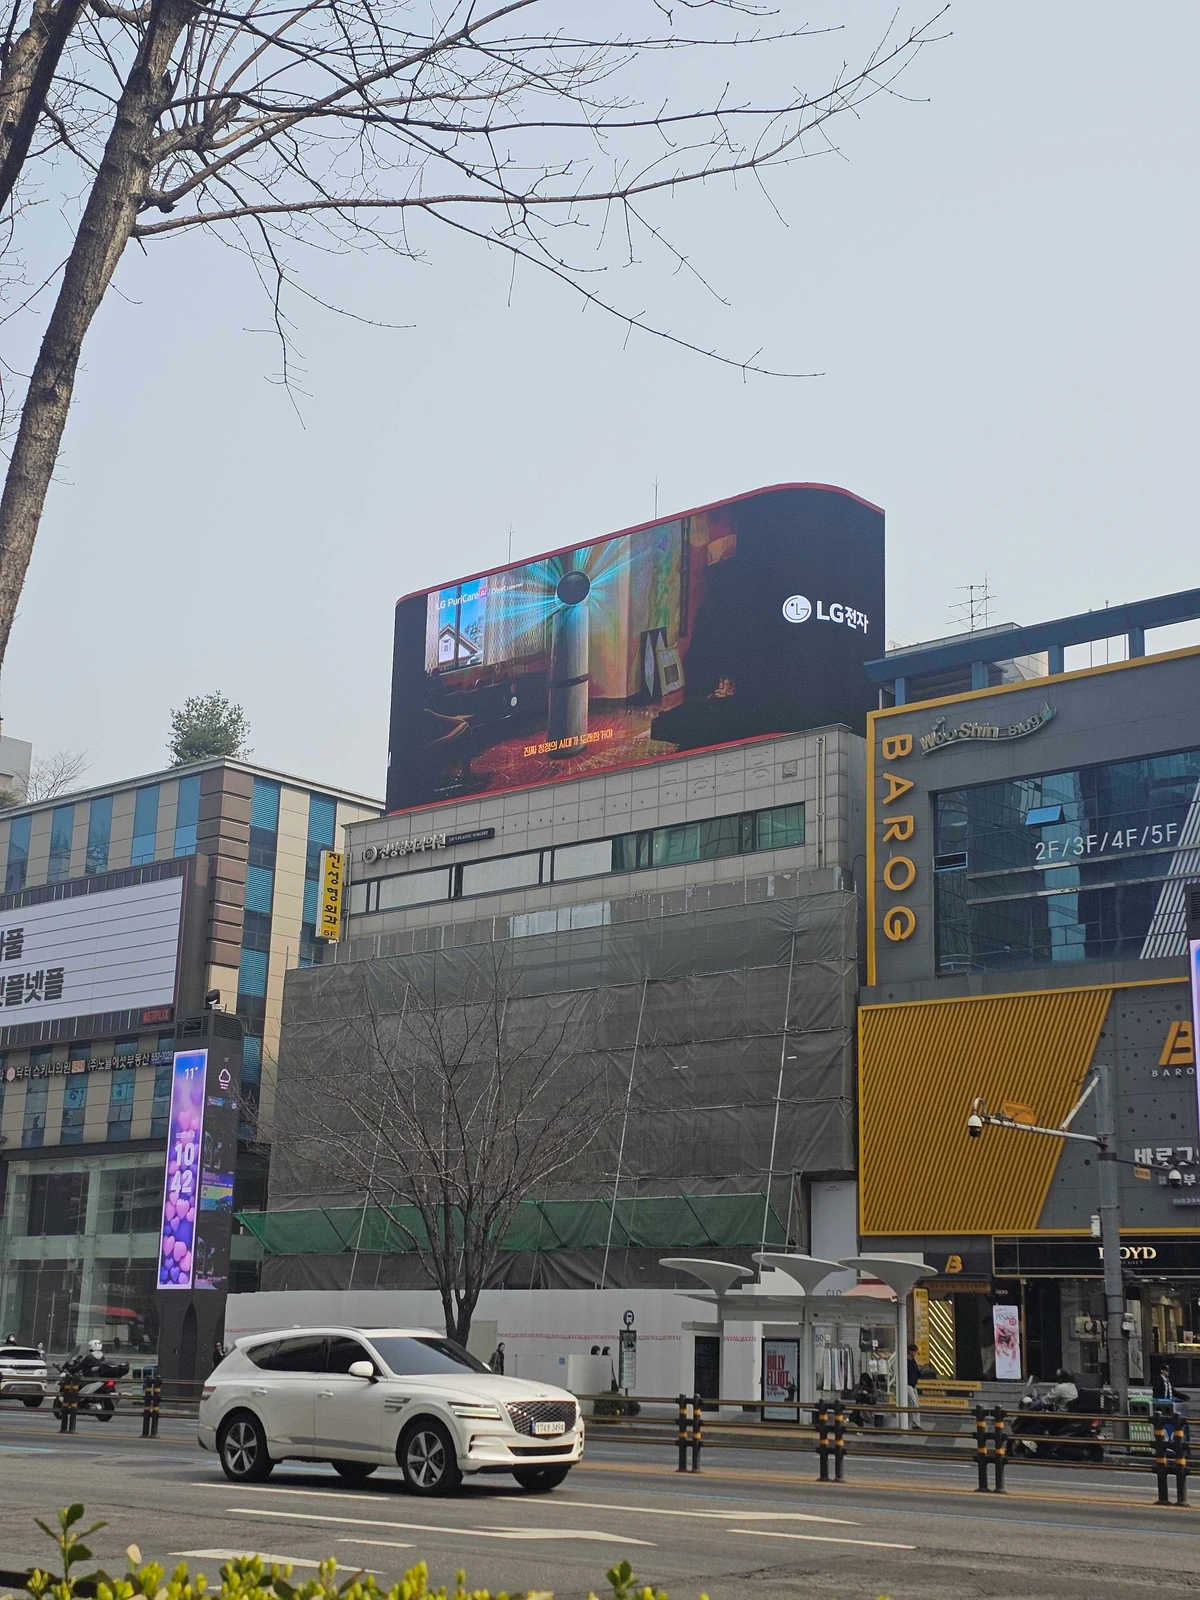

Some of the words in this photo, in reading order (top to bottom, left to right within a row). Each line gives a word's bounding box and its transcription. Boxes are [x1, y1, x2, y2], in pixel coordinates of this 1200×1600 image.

[448, 592, 479, 608] PuriCare
[480, 588, 488, 598] AI
[816, 600, 869, 634] LG전자
[524, 744, 536, 758] 진짜
[538, 740, 558, 754] 청정의
[558, 736, 579, 749] 시대가
[882, 733, 916, 942] BAROG
[0, 928, 24, 962] 풀
[184, 1066, 198, 1080] 11°
[174, 1142, 195, 1166] 10
[1134, 1146, 1200, 1166] 바로그
[171, 1170, 193, 1193] 42
[767, 1355, 786, 1370] BILLY
[767, 1371, 789, 1386] ELLIOT
